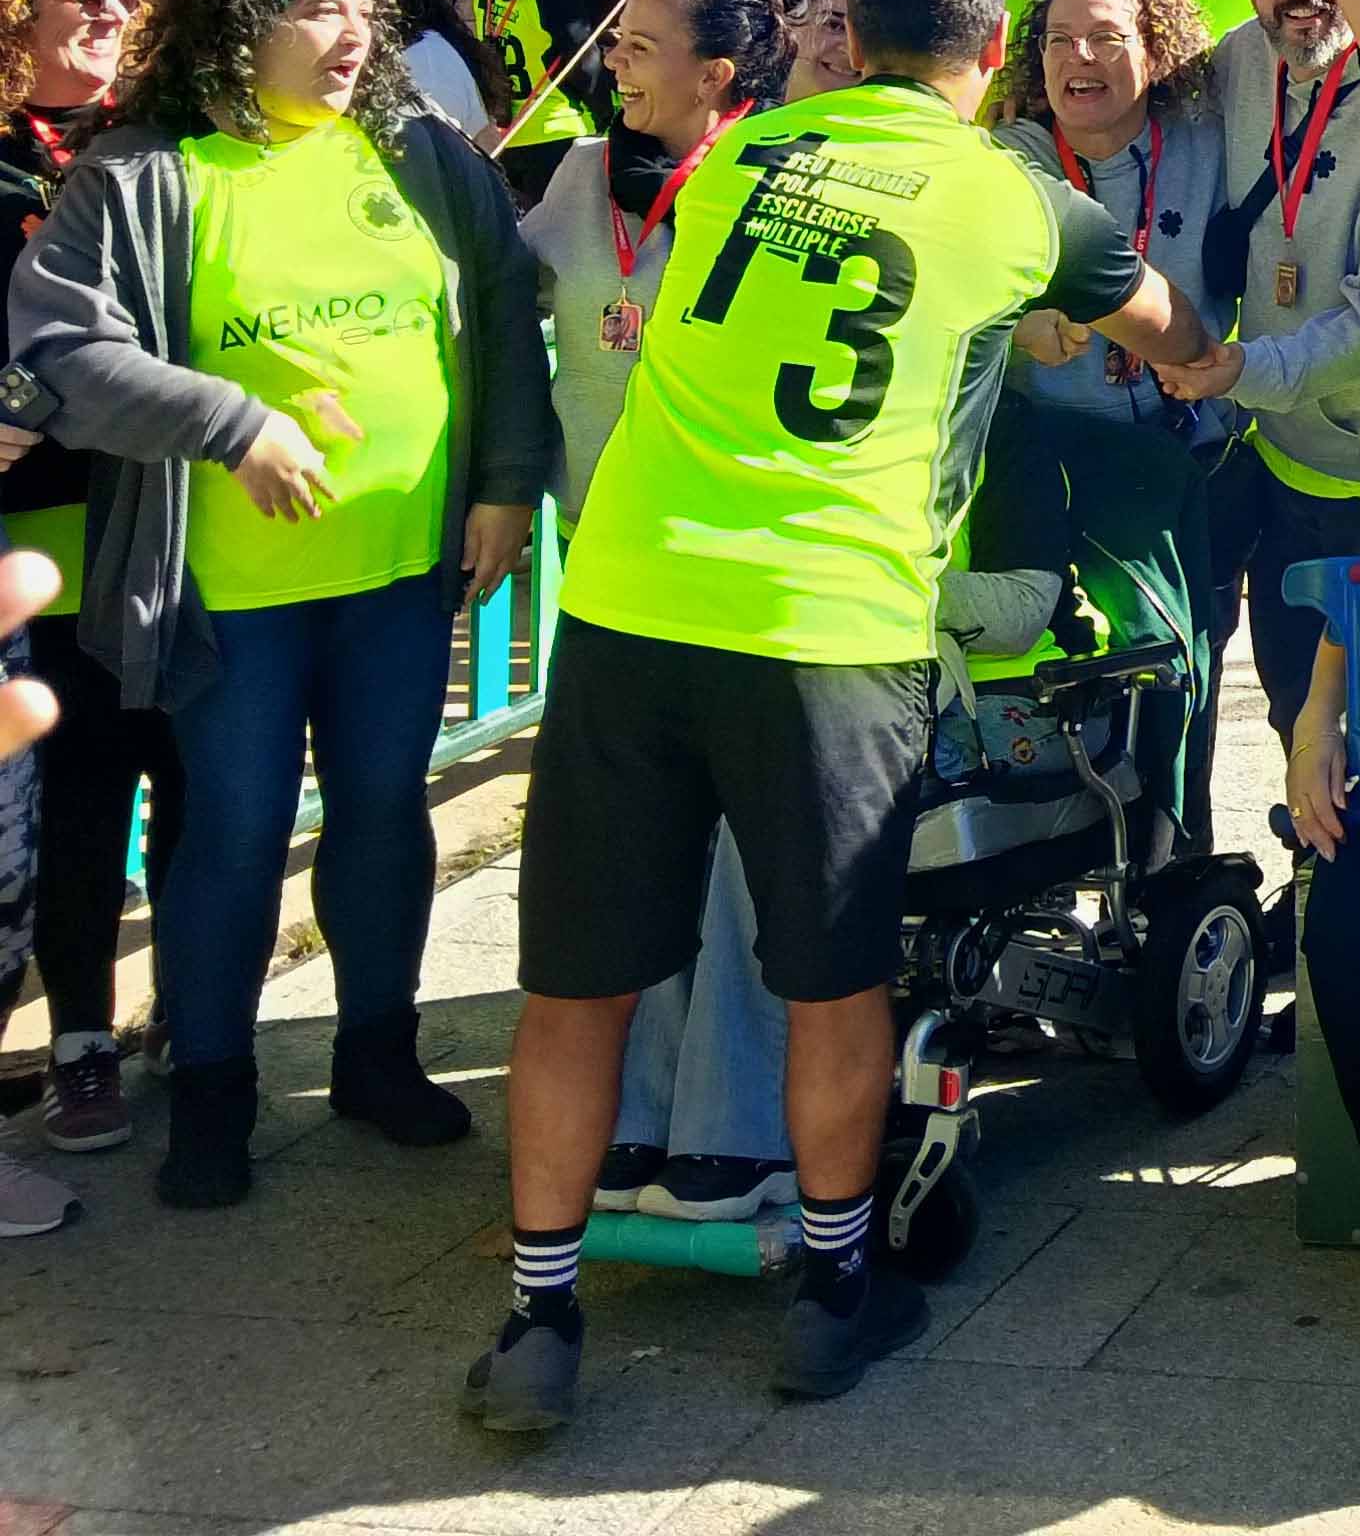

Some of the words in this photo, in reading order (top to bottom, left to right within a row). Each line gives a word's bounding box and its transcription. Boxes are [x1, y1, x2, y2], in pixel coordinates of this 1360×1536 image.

[770, 172, 825, 200] POLA
[745, 216, 848, 258] MÚLTIPLE
[757, 193, 877, 239] ESCLEROSE
[220, 291, 385, 352] AVEMPO
